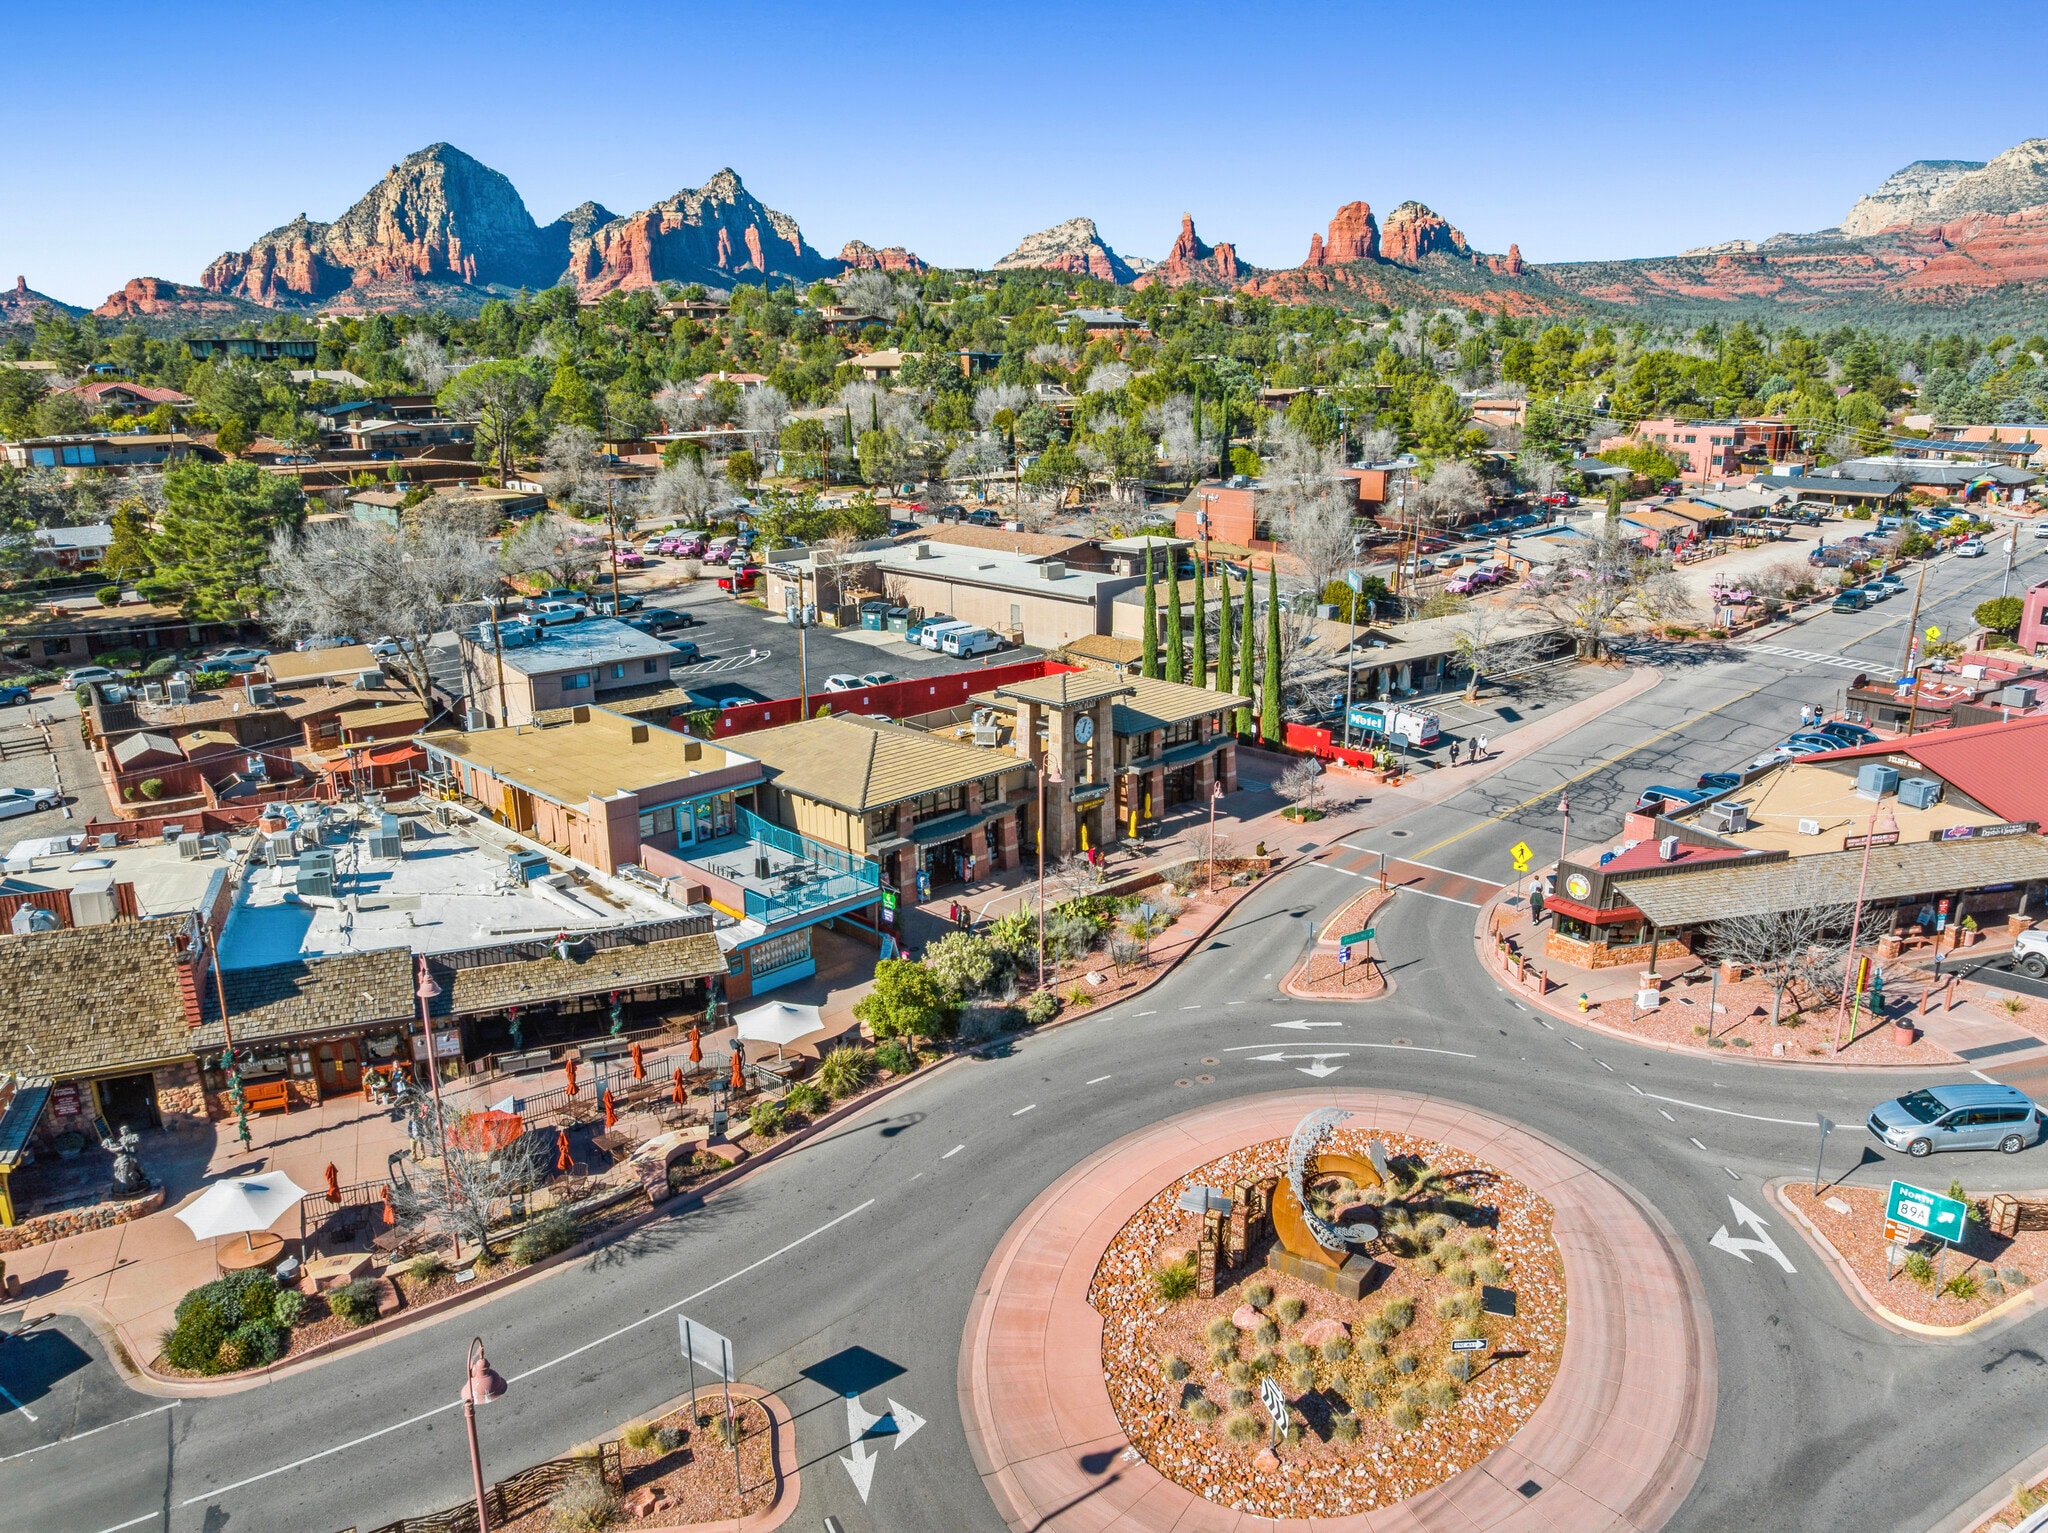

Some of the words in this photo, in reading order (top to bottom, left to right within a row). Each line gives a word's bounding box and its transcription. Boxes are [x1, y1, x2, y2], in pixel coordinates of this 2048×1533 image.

[1351, 713, 1382, 728] Motel
[1861, 833, 1888, 842] FDGE
[1899, 1187, 1935, 1206] NORTH
[1900, 1203, 1926, 1220] 89A
